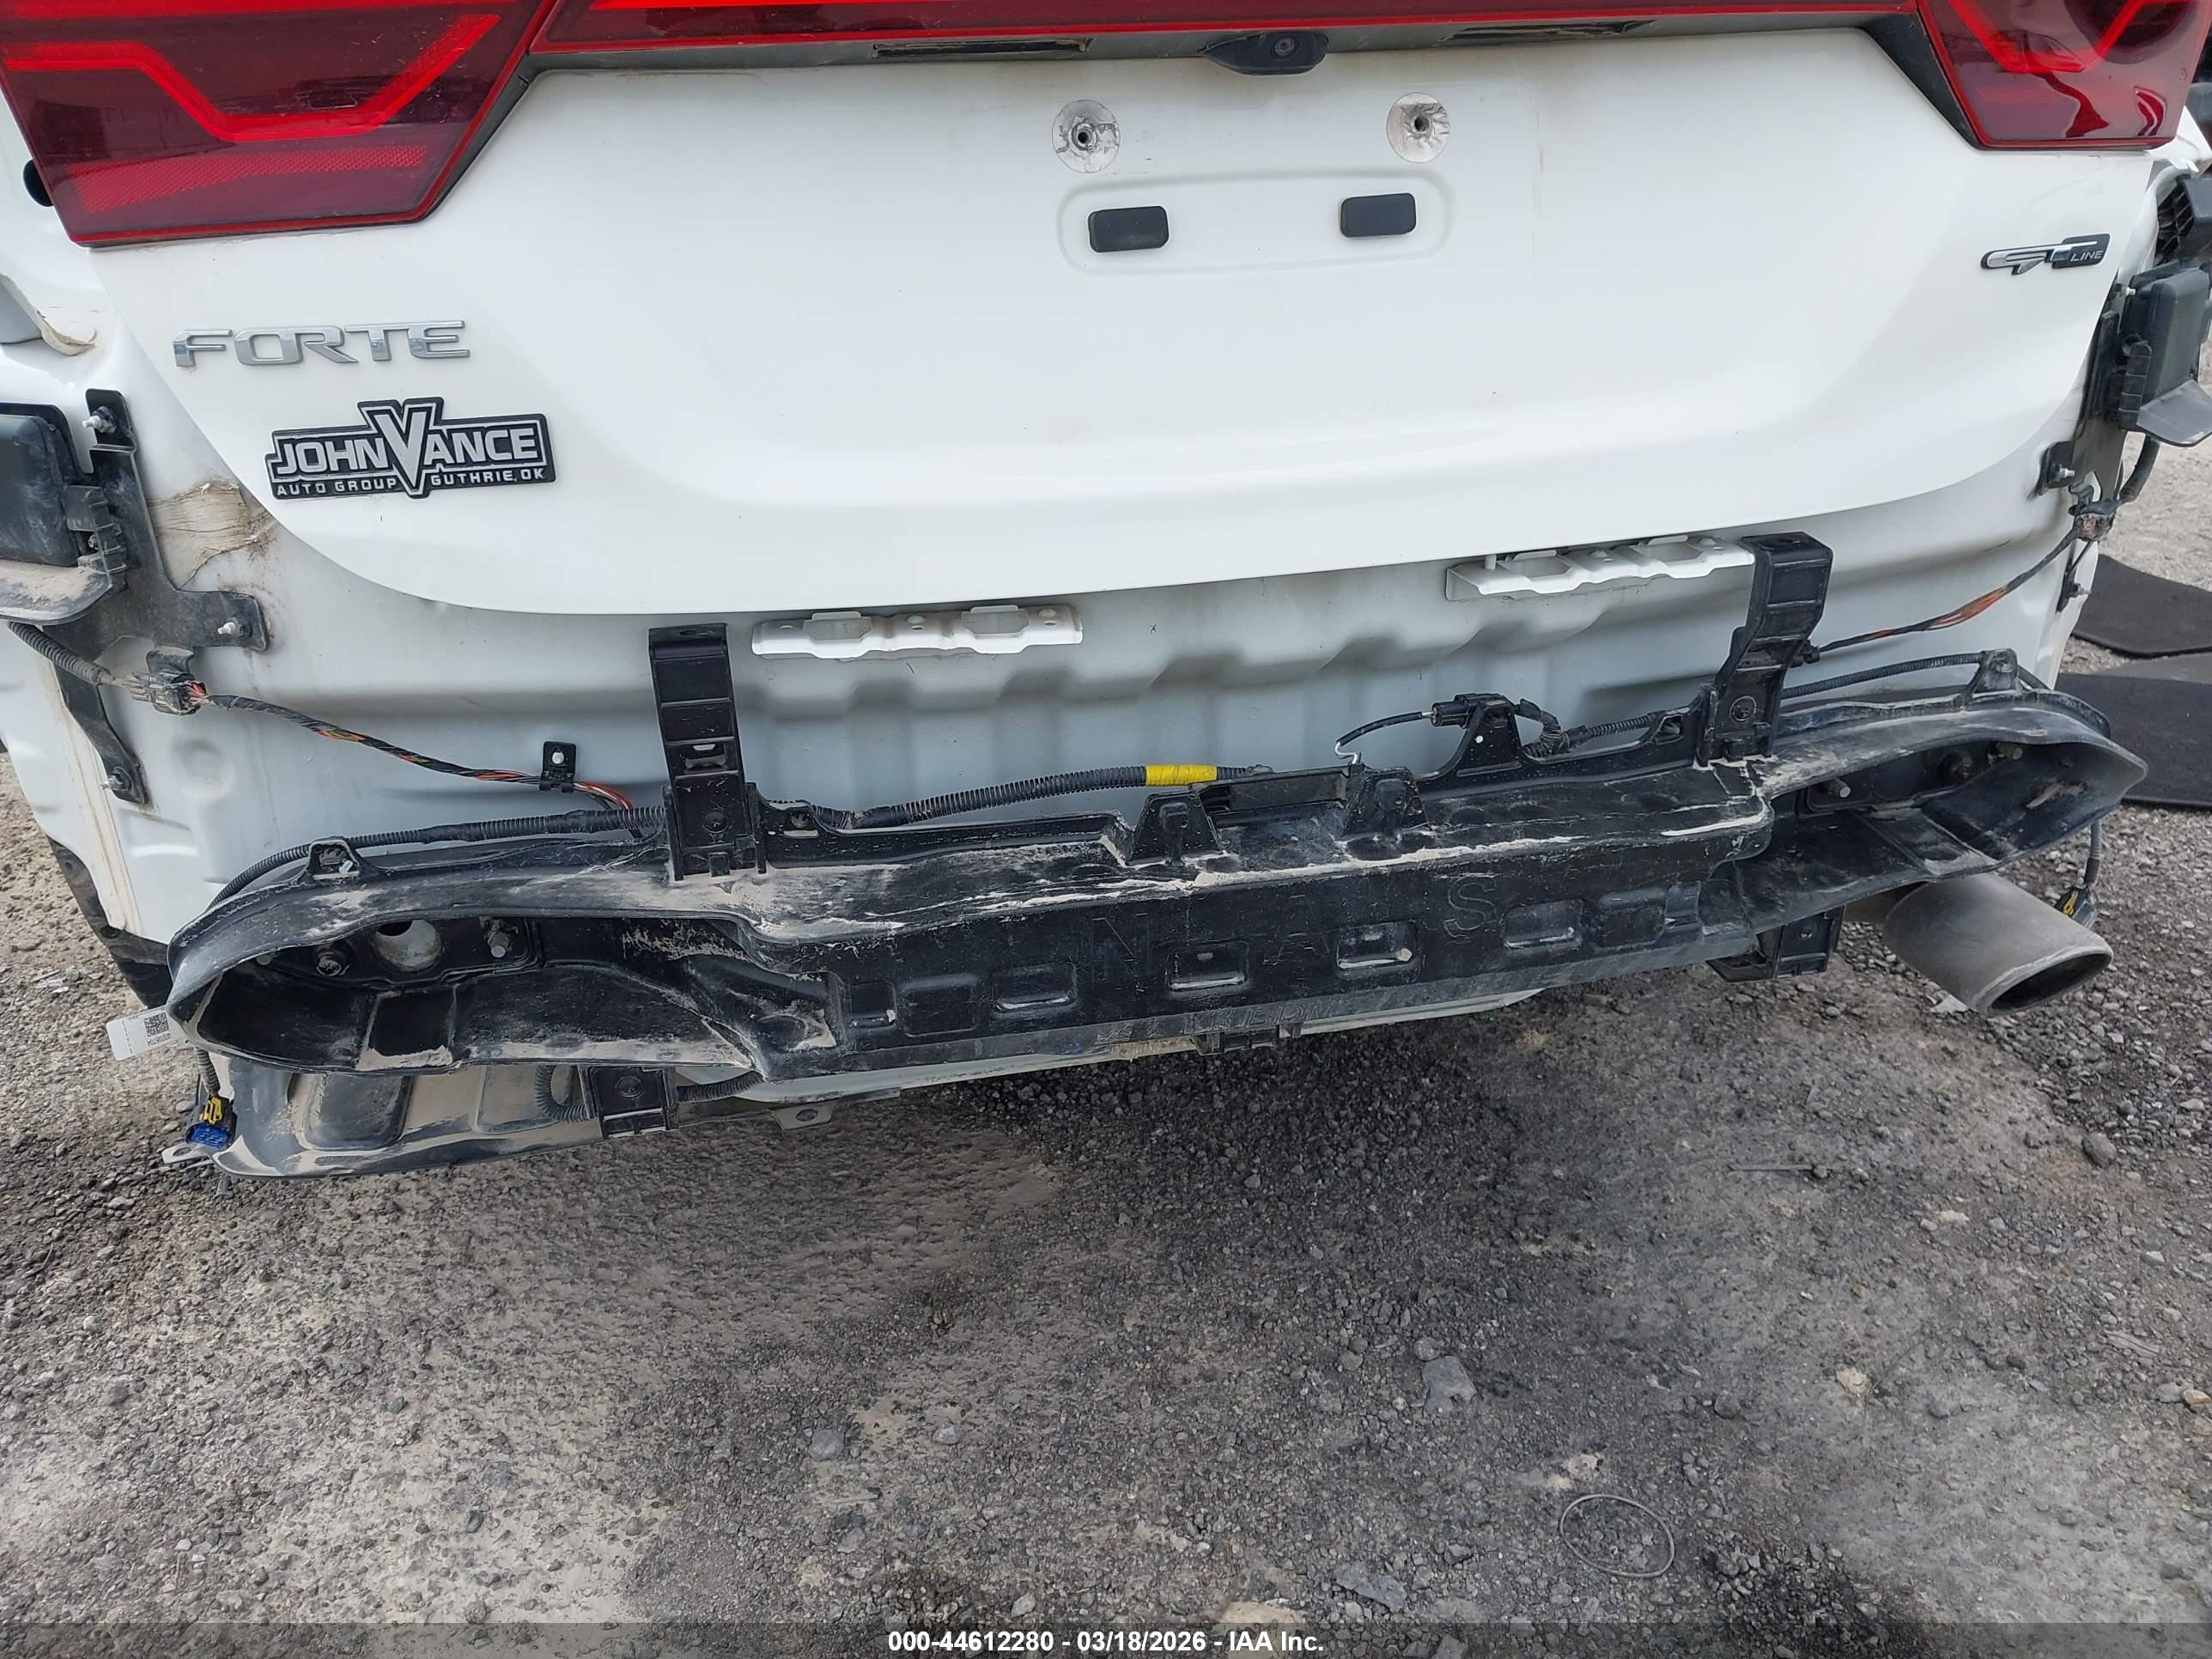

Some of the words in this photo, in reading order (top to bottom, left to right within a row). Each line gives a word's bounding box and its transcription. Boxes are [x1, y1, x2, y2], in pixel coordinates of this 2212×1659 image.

[2069, 249, 2104, 263] LINE
[173, 319, 471, 368] FORTE
[276, 437, 389, 475] JOHN
[373, 411, 538, 488] VANCE
[276, 482, 327, 496] AUTO
[334, 477, 398, 493] GROUP
[520, 467, 546, 481] OK
